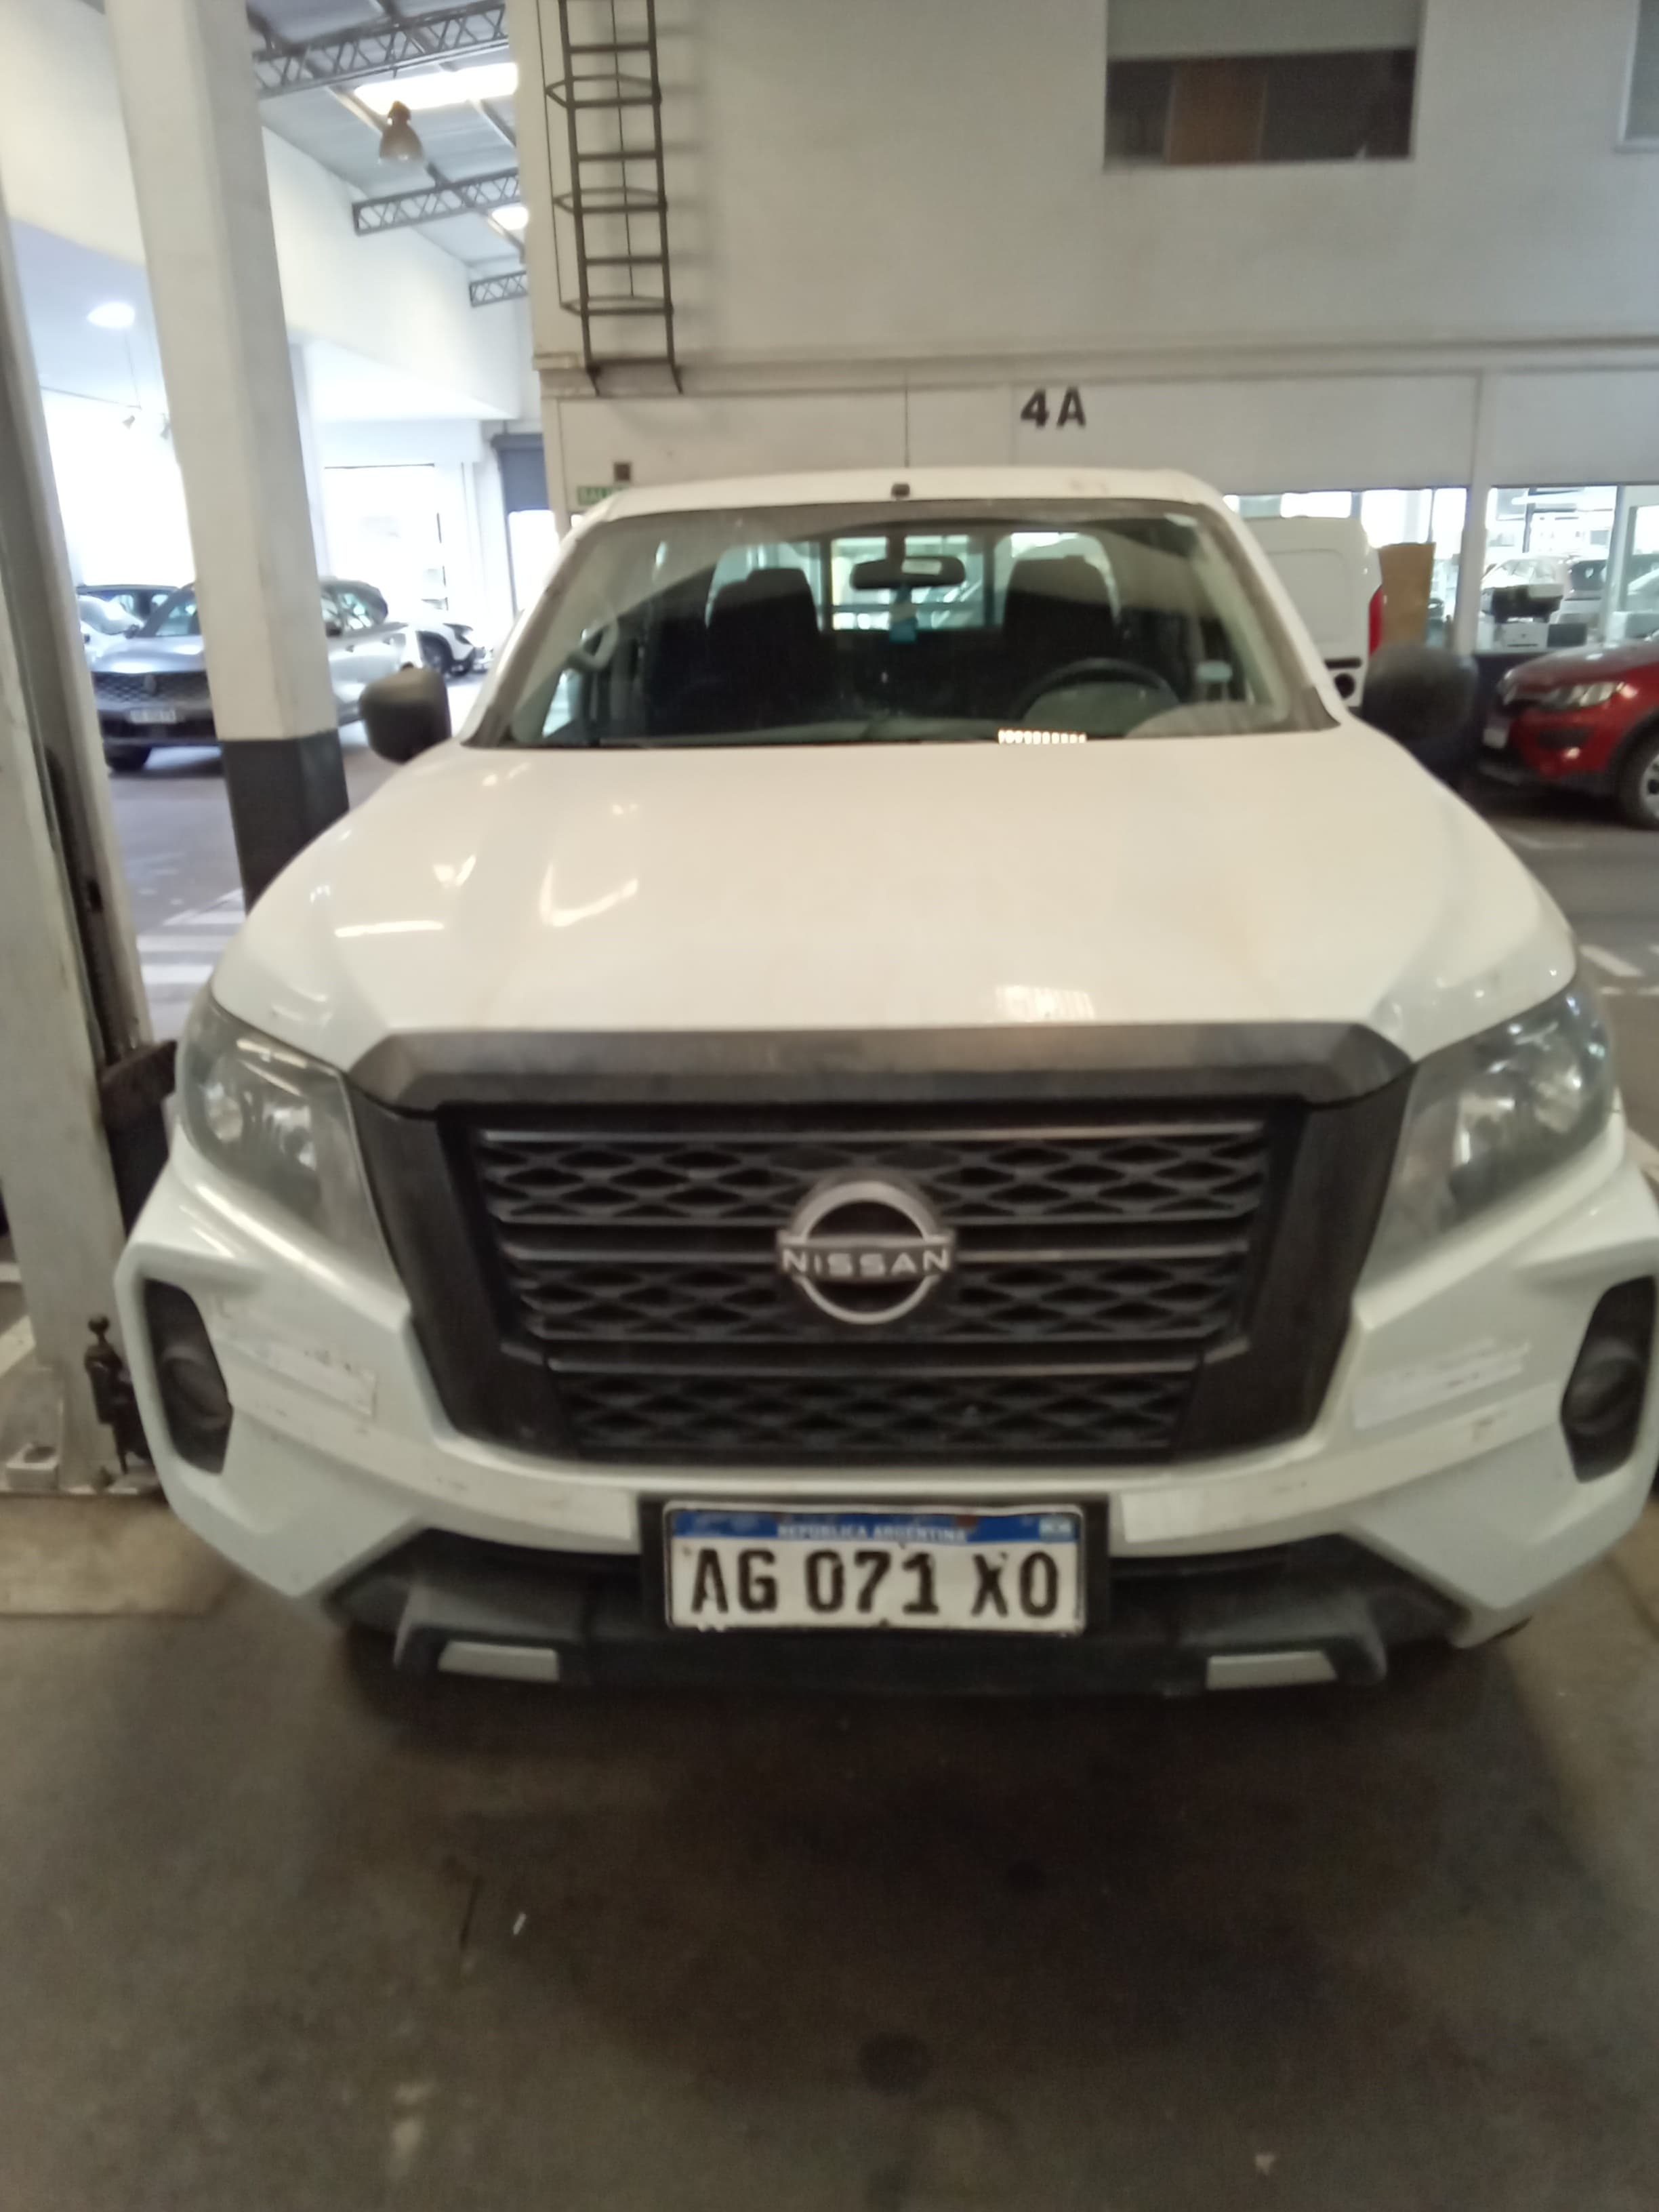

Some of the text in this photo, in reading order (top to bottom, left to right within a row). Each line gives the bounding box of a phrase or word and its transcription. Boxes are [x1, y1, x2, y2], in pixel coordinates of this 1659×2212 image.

[1020, 387, 1086, 428] 4A
[781, 1249, 949, 1275] NISSAN
[691, 1549, 779, 1613] AG
[804, 1549, 939, 1616] 071
